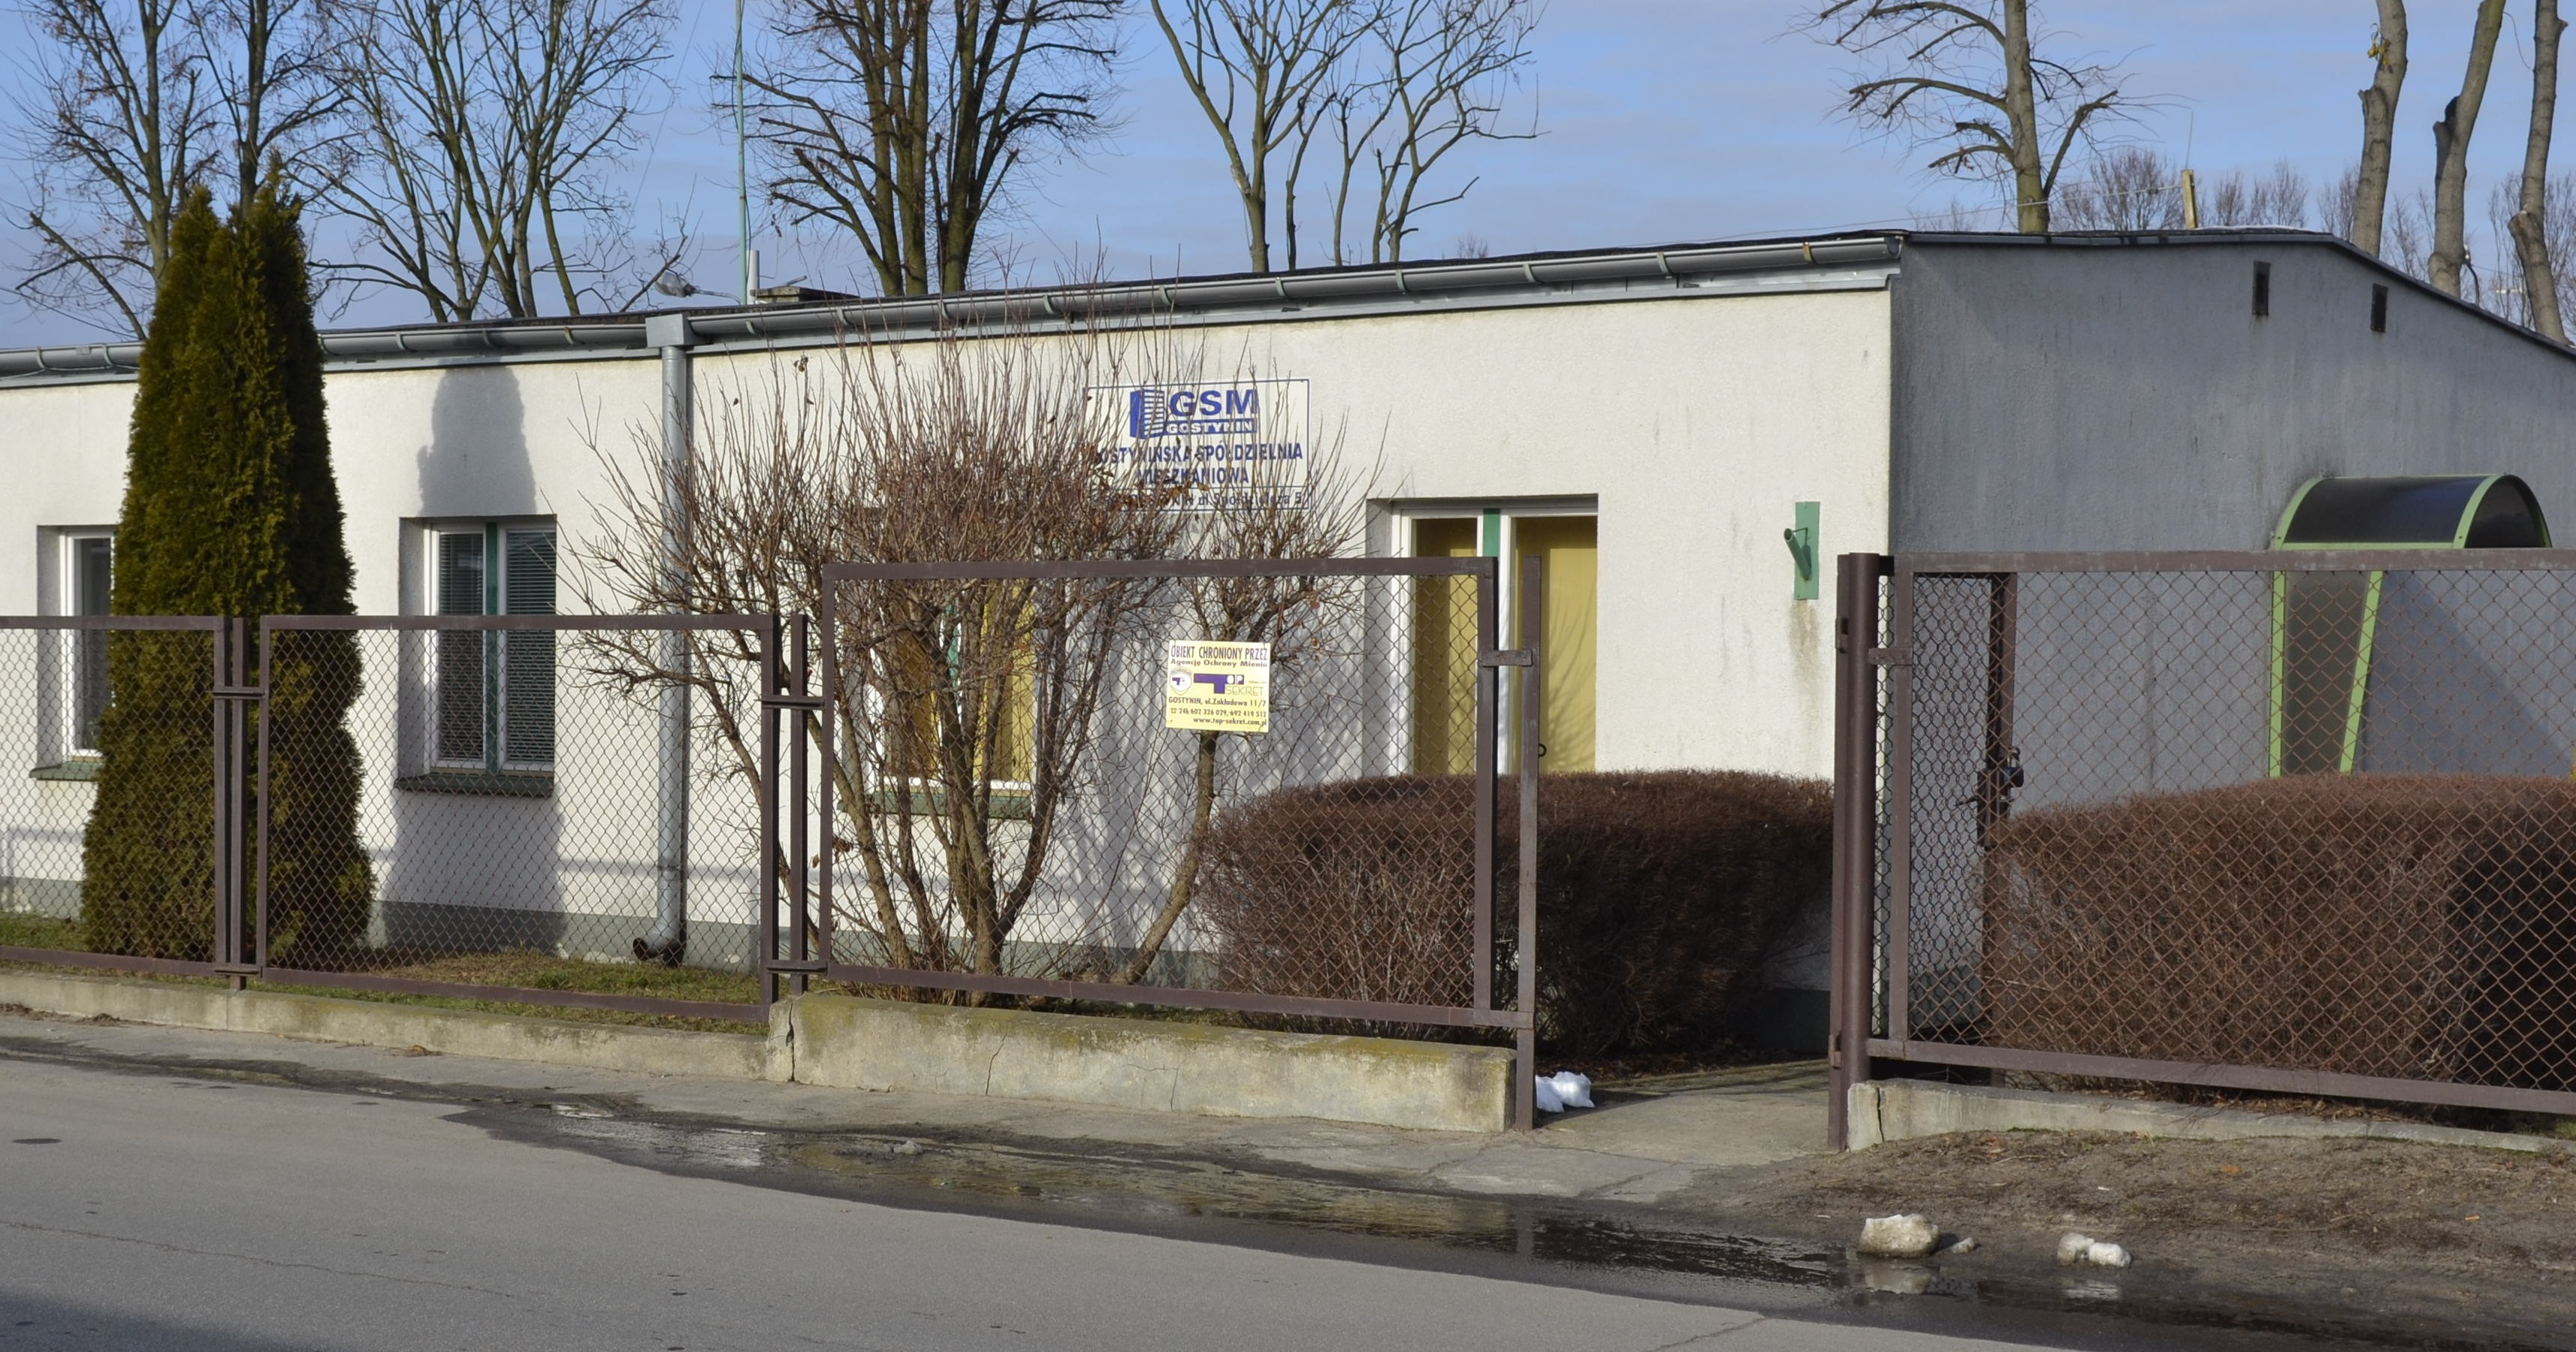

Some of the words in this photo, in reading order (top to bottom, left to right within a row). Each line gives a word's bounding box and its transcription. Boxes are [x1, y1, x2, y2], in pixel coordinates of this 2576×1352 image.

[1170, 389, 1258, 417] GSM
[1166, 421, 1253, 434] GOSTYNIN
[1195, 440, 1303, 462] SPÓDZIELNIA
[1170, 645, 1195, 658] OBIEKT
[1199, 646, 1243, 659] CHRONIONY
[1245, 647, 1268, 661] PRZEZ
[1203, 659, 1237, 668] Ochrony
[1225, 685, 1265, 696] SEKRET
[1250, 699, 1267, 708] 11/7
